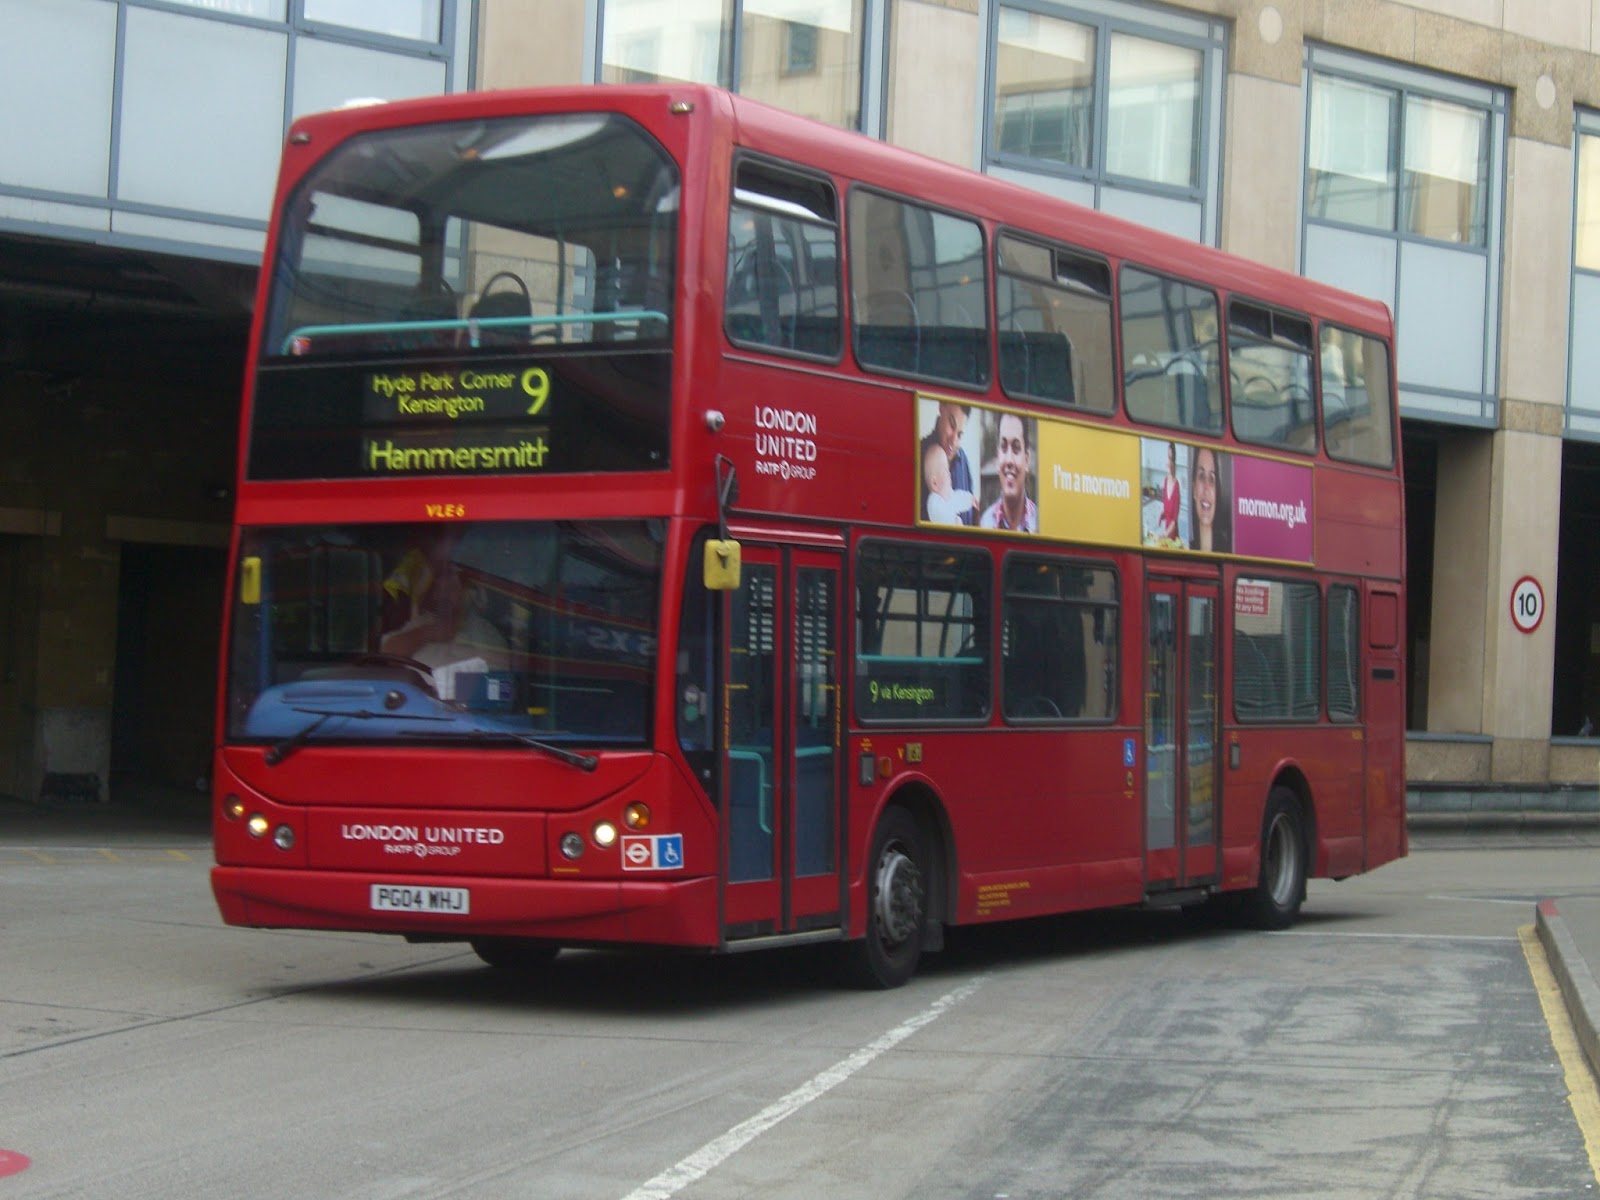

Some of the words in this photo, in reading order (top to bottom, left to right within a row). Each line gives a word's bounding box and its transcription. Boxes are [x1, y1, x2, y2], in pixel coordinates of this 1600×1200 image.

[373, 374, 416, 397] Hyde
[420, 372, 454, 391] Park
[459, 370, 516, 390] Corner
[521, 367, 550, 415] 9
[398, 394, 484, 418] Kensington
[755, 405, 817, 435] LONDON
[370, 437, 549, 470] Hammersmith
[755, 432, 817, 462] UNITED
[755, 460, 780, 476] RATP
[790, 464, 817, 481] GROUP
[1053, 463, 1073, 491] I'm
[1073, 472, 1081, 493] a
[1081, 474, 1131, 499] mormon
[425, 503, 466, 518] VLE6
[1238, 496, 1308, 529] mormon.org.uk
[1519, 593, 1537, 617] 10
[869, 680, 879, 703] 9
[893, 682, 935, 705] Kensington
[341, 824, 419, 842] LONDON
[424, 826, 505, 845] UNITED
[383, 843, 414, 855] RATP
[427, 845, 461, 857] GROUP
[378, 887, 423, 910] PG04
[428, 890, 463, 911] WHJ
